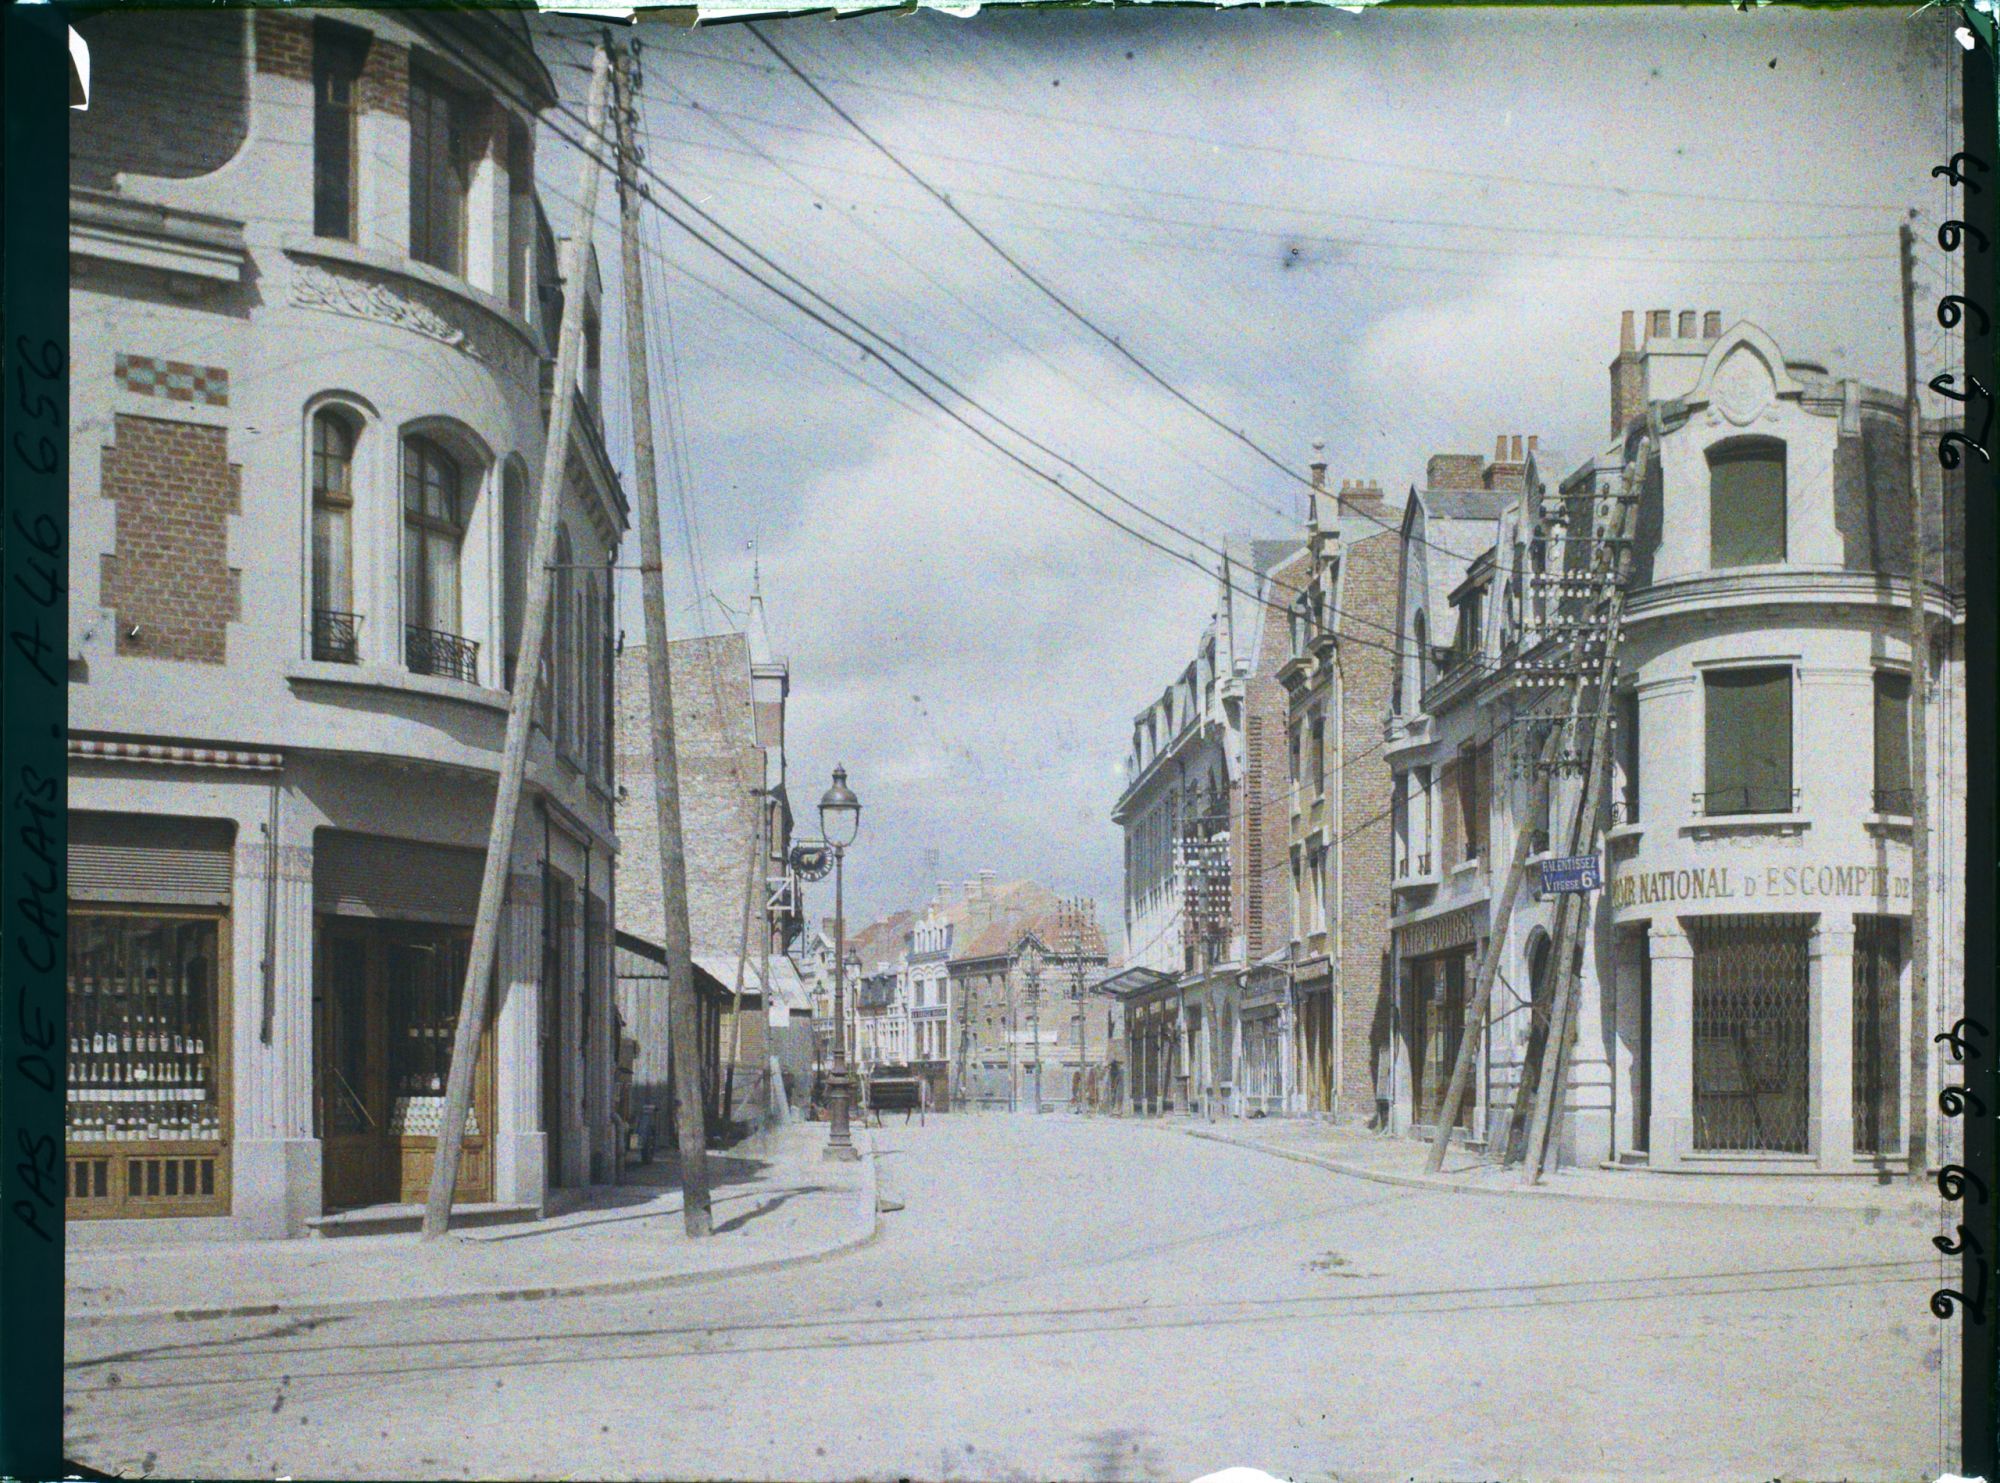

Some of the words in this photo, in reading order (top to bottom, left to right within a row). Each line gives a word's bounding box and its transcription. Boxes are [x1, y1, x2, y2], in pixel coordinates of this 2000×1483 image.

[14, 334, 64, 475] 656
[13, 510, 66, 608] 46
[10, 614, 59, 687] A
[1542, 857, 1596, 872] RALENTISSEZ
[1639, 867, 1735, 904] NATIONAL
[1894, 876, 1911, 898] DE
[17, 987, 56, 1092] DE
[12, 1129, 58, 1243] PAS
